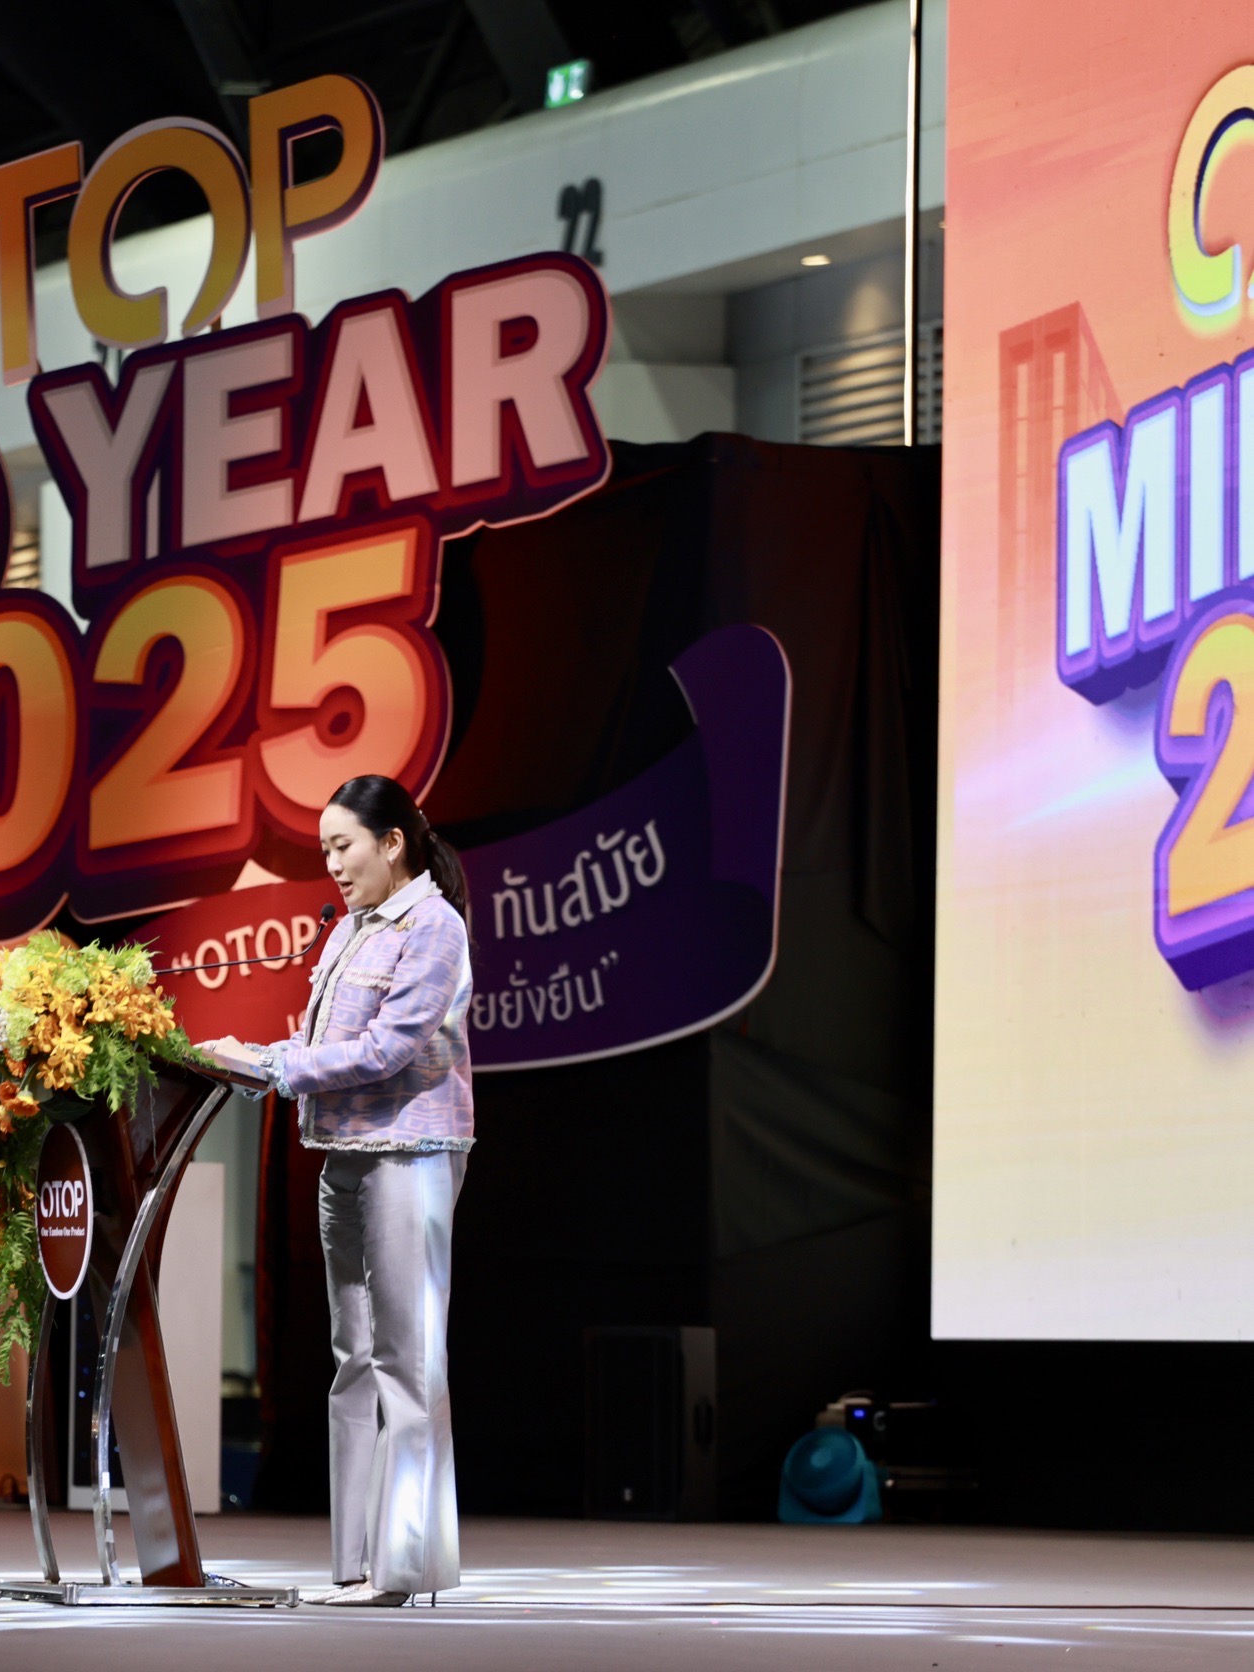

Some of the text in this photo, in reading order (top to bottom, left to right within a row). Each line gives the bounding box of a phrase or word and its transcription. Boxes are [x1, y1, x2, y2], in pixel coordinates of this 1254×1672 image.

[39, 264, 595, 574] YEAR
[1064, 365, 1254, 658] MI
[492, 819, 665, 939] ทันสมัย
[40, 1180, 84, 1218] OTOP
